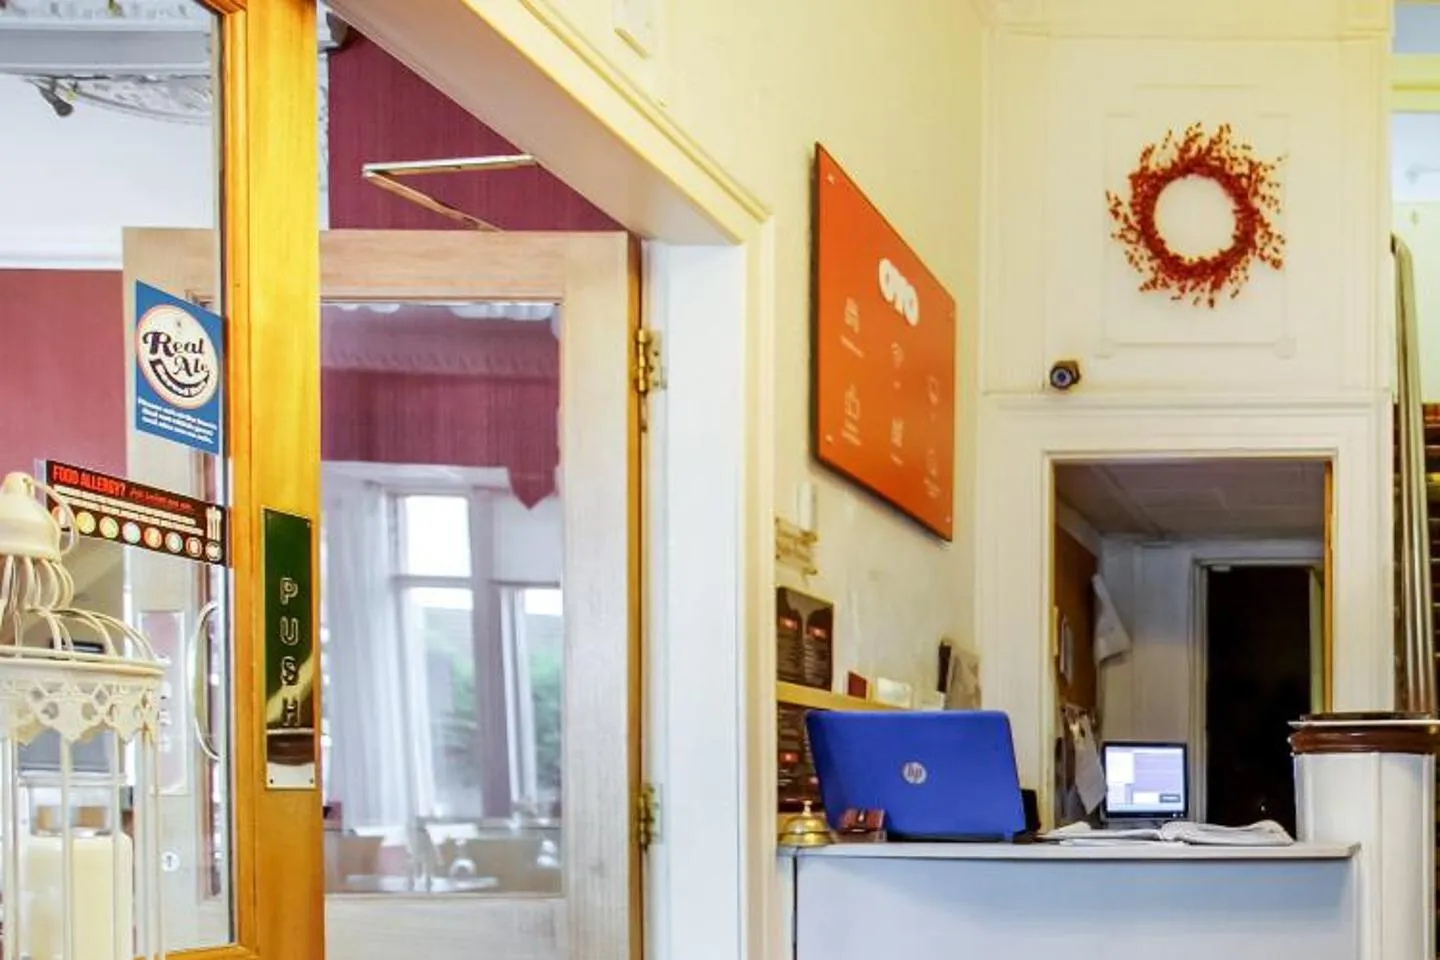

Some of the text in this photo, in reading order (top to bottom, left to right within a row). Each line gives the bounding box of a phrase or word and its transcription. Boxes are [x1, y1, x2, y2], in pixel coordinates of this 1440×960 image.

[142, 330, 204, 358] Real
[173, 355, 209, 377] Ale
[52, 464, 80, 486] FOOD
[79, 471, 126, 498] ALLERGY?
[279, 576, 300, 727] PUSH
